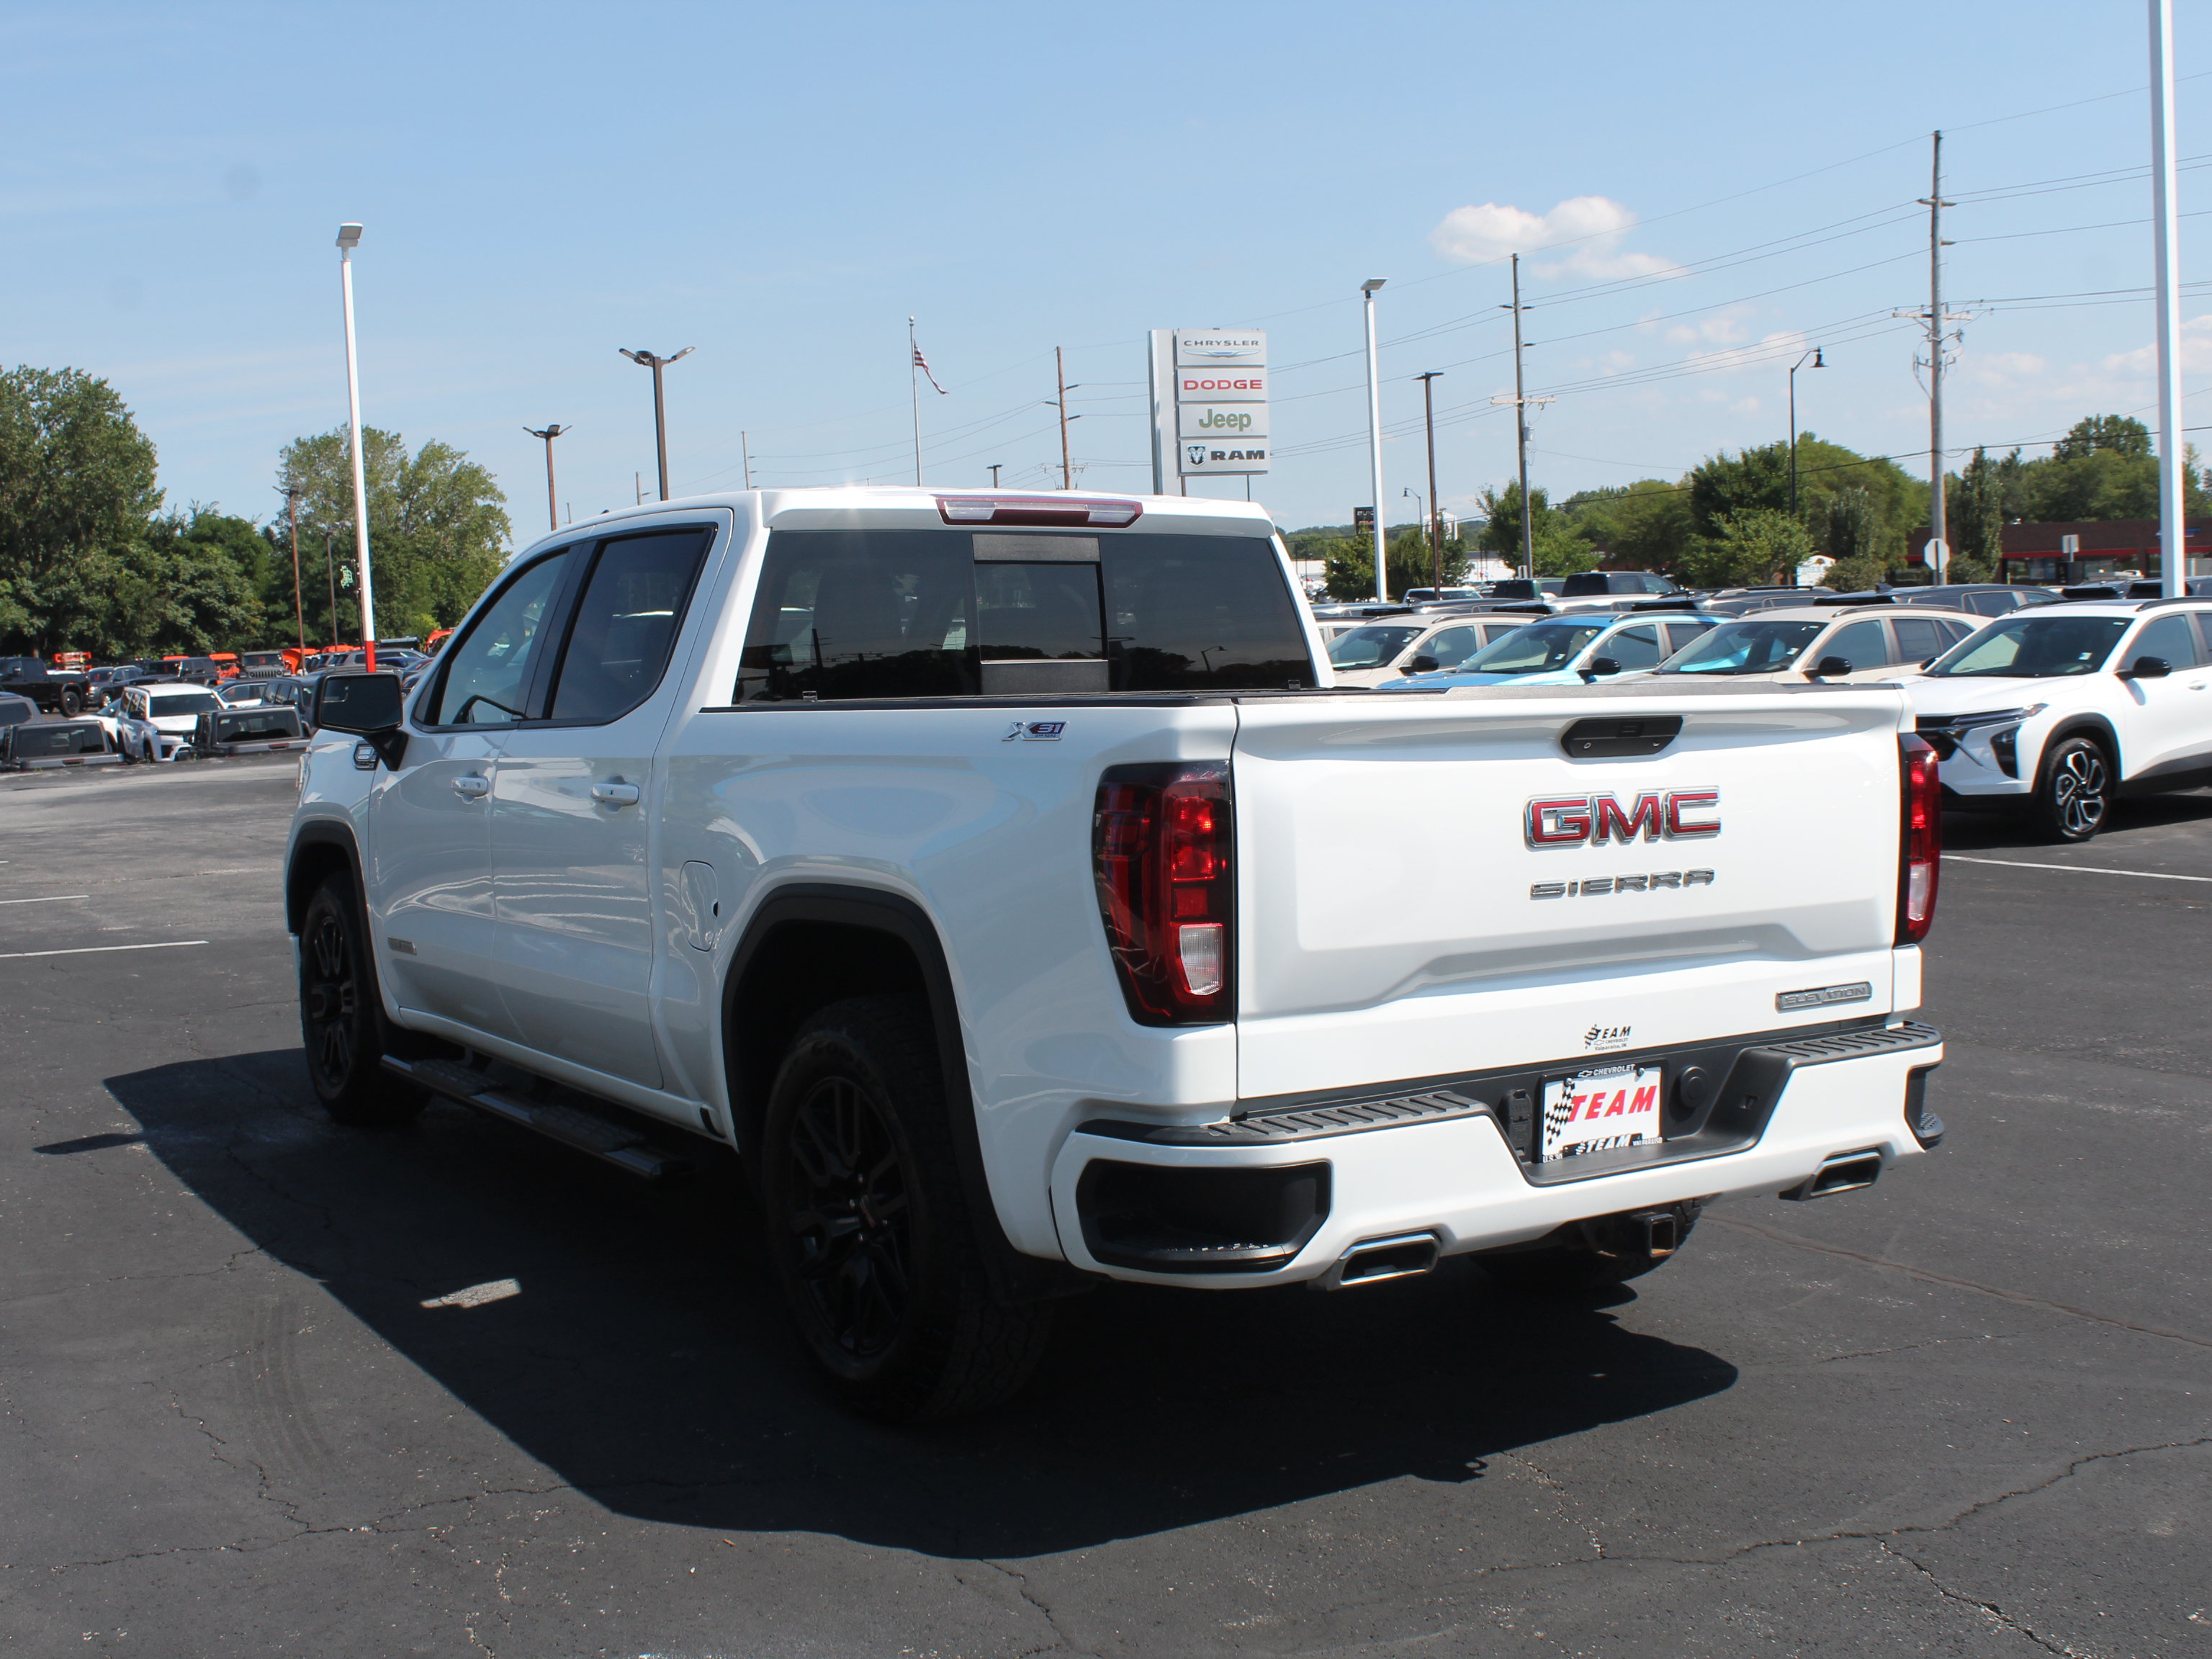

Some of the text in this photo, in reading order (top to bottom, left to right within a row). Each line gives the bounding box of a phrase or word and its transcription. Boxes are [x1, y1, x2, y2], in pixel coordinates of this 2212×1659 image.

[1184, 379, 1262, 390] DODGE
[1199, 409, 1251, 431] Jeep
[1210, 450, 1265, 460] RAM
[1523, 786, 1722, 852] GMC
[1530, 868, 1715, 900] SIERRA
[1784, 986, 1866, 1004] ELEVATION
[1592, 1025, 1631, 1040] TEAM
[1593, 1064, 1635, 1076] CHEVROLET
[1568, 1085, 1658, 1123] TEAM
[1586, 1134, 1632, 1153] TEAM
